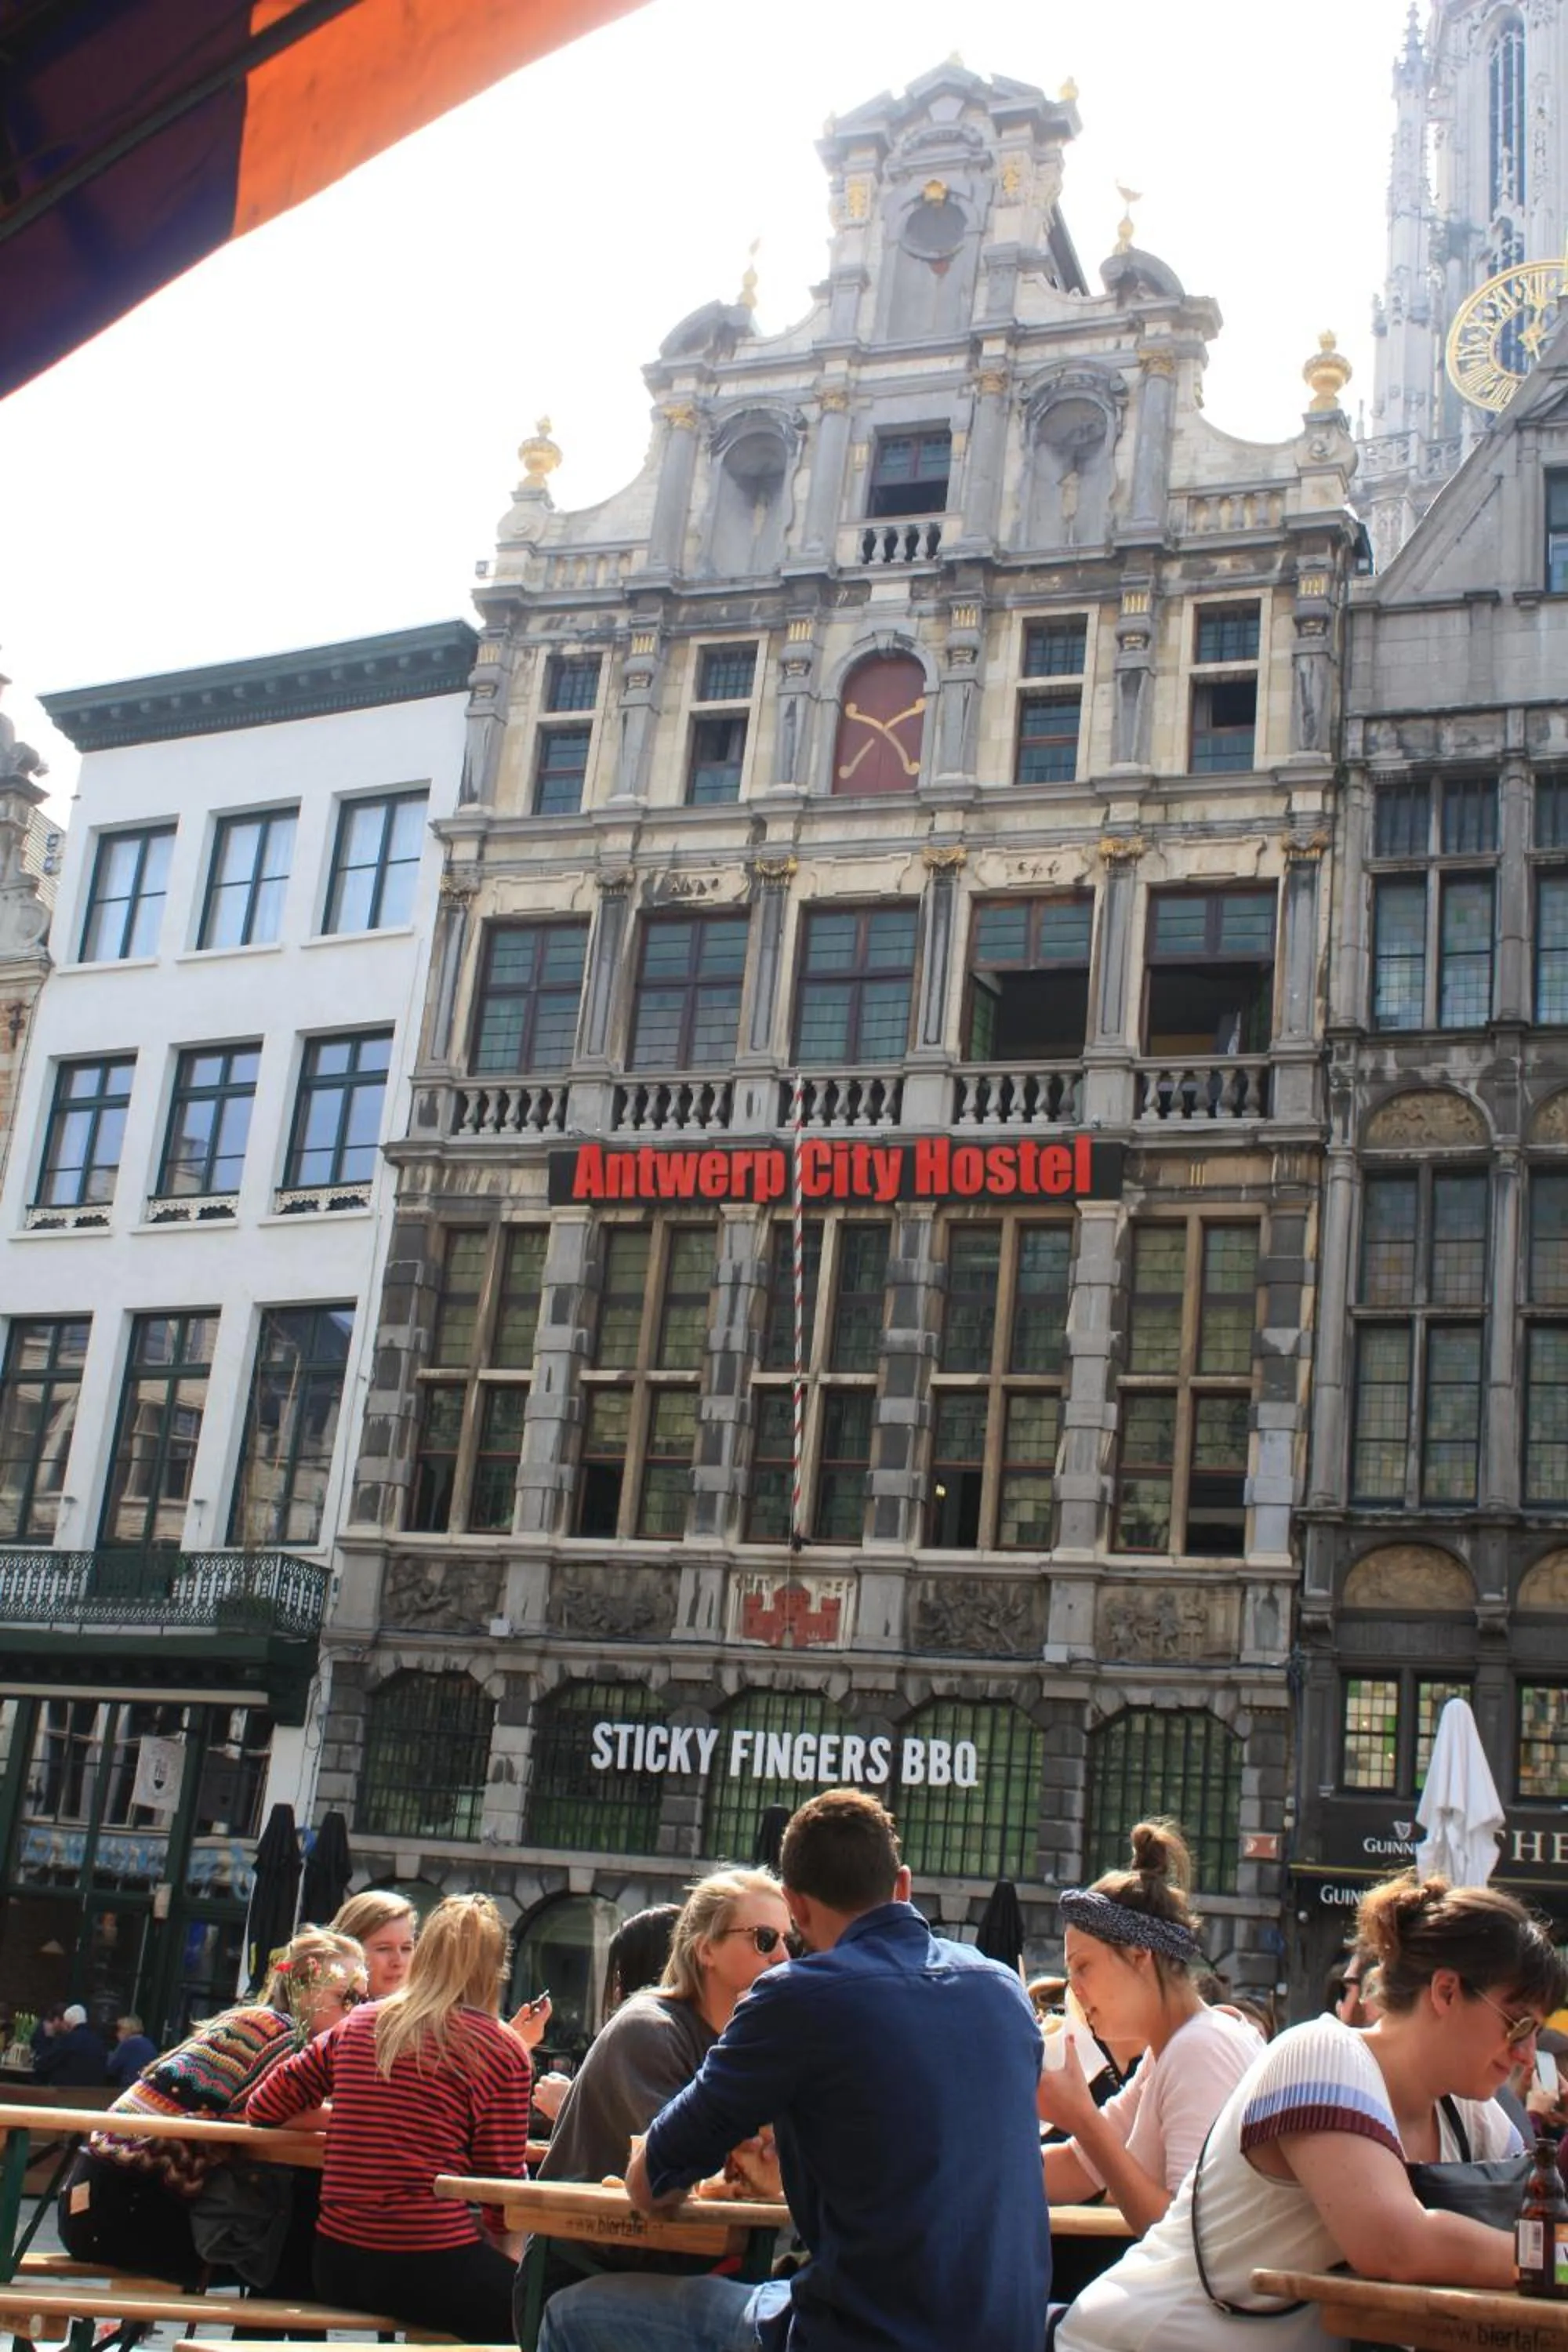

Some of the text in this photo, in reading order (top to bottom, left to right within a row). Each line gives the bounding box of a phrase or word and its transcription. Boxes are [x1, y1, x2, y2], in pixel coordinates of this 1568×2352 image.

[572, 1134, 1092, 1203] Antwerp City Hostel
[591, 1722, 979, 1788] STICKY FINGERS BBQ
